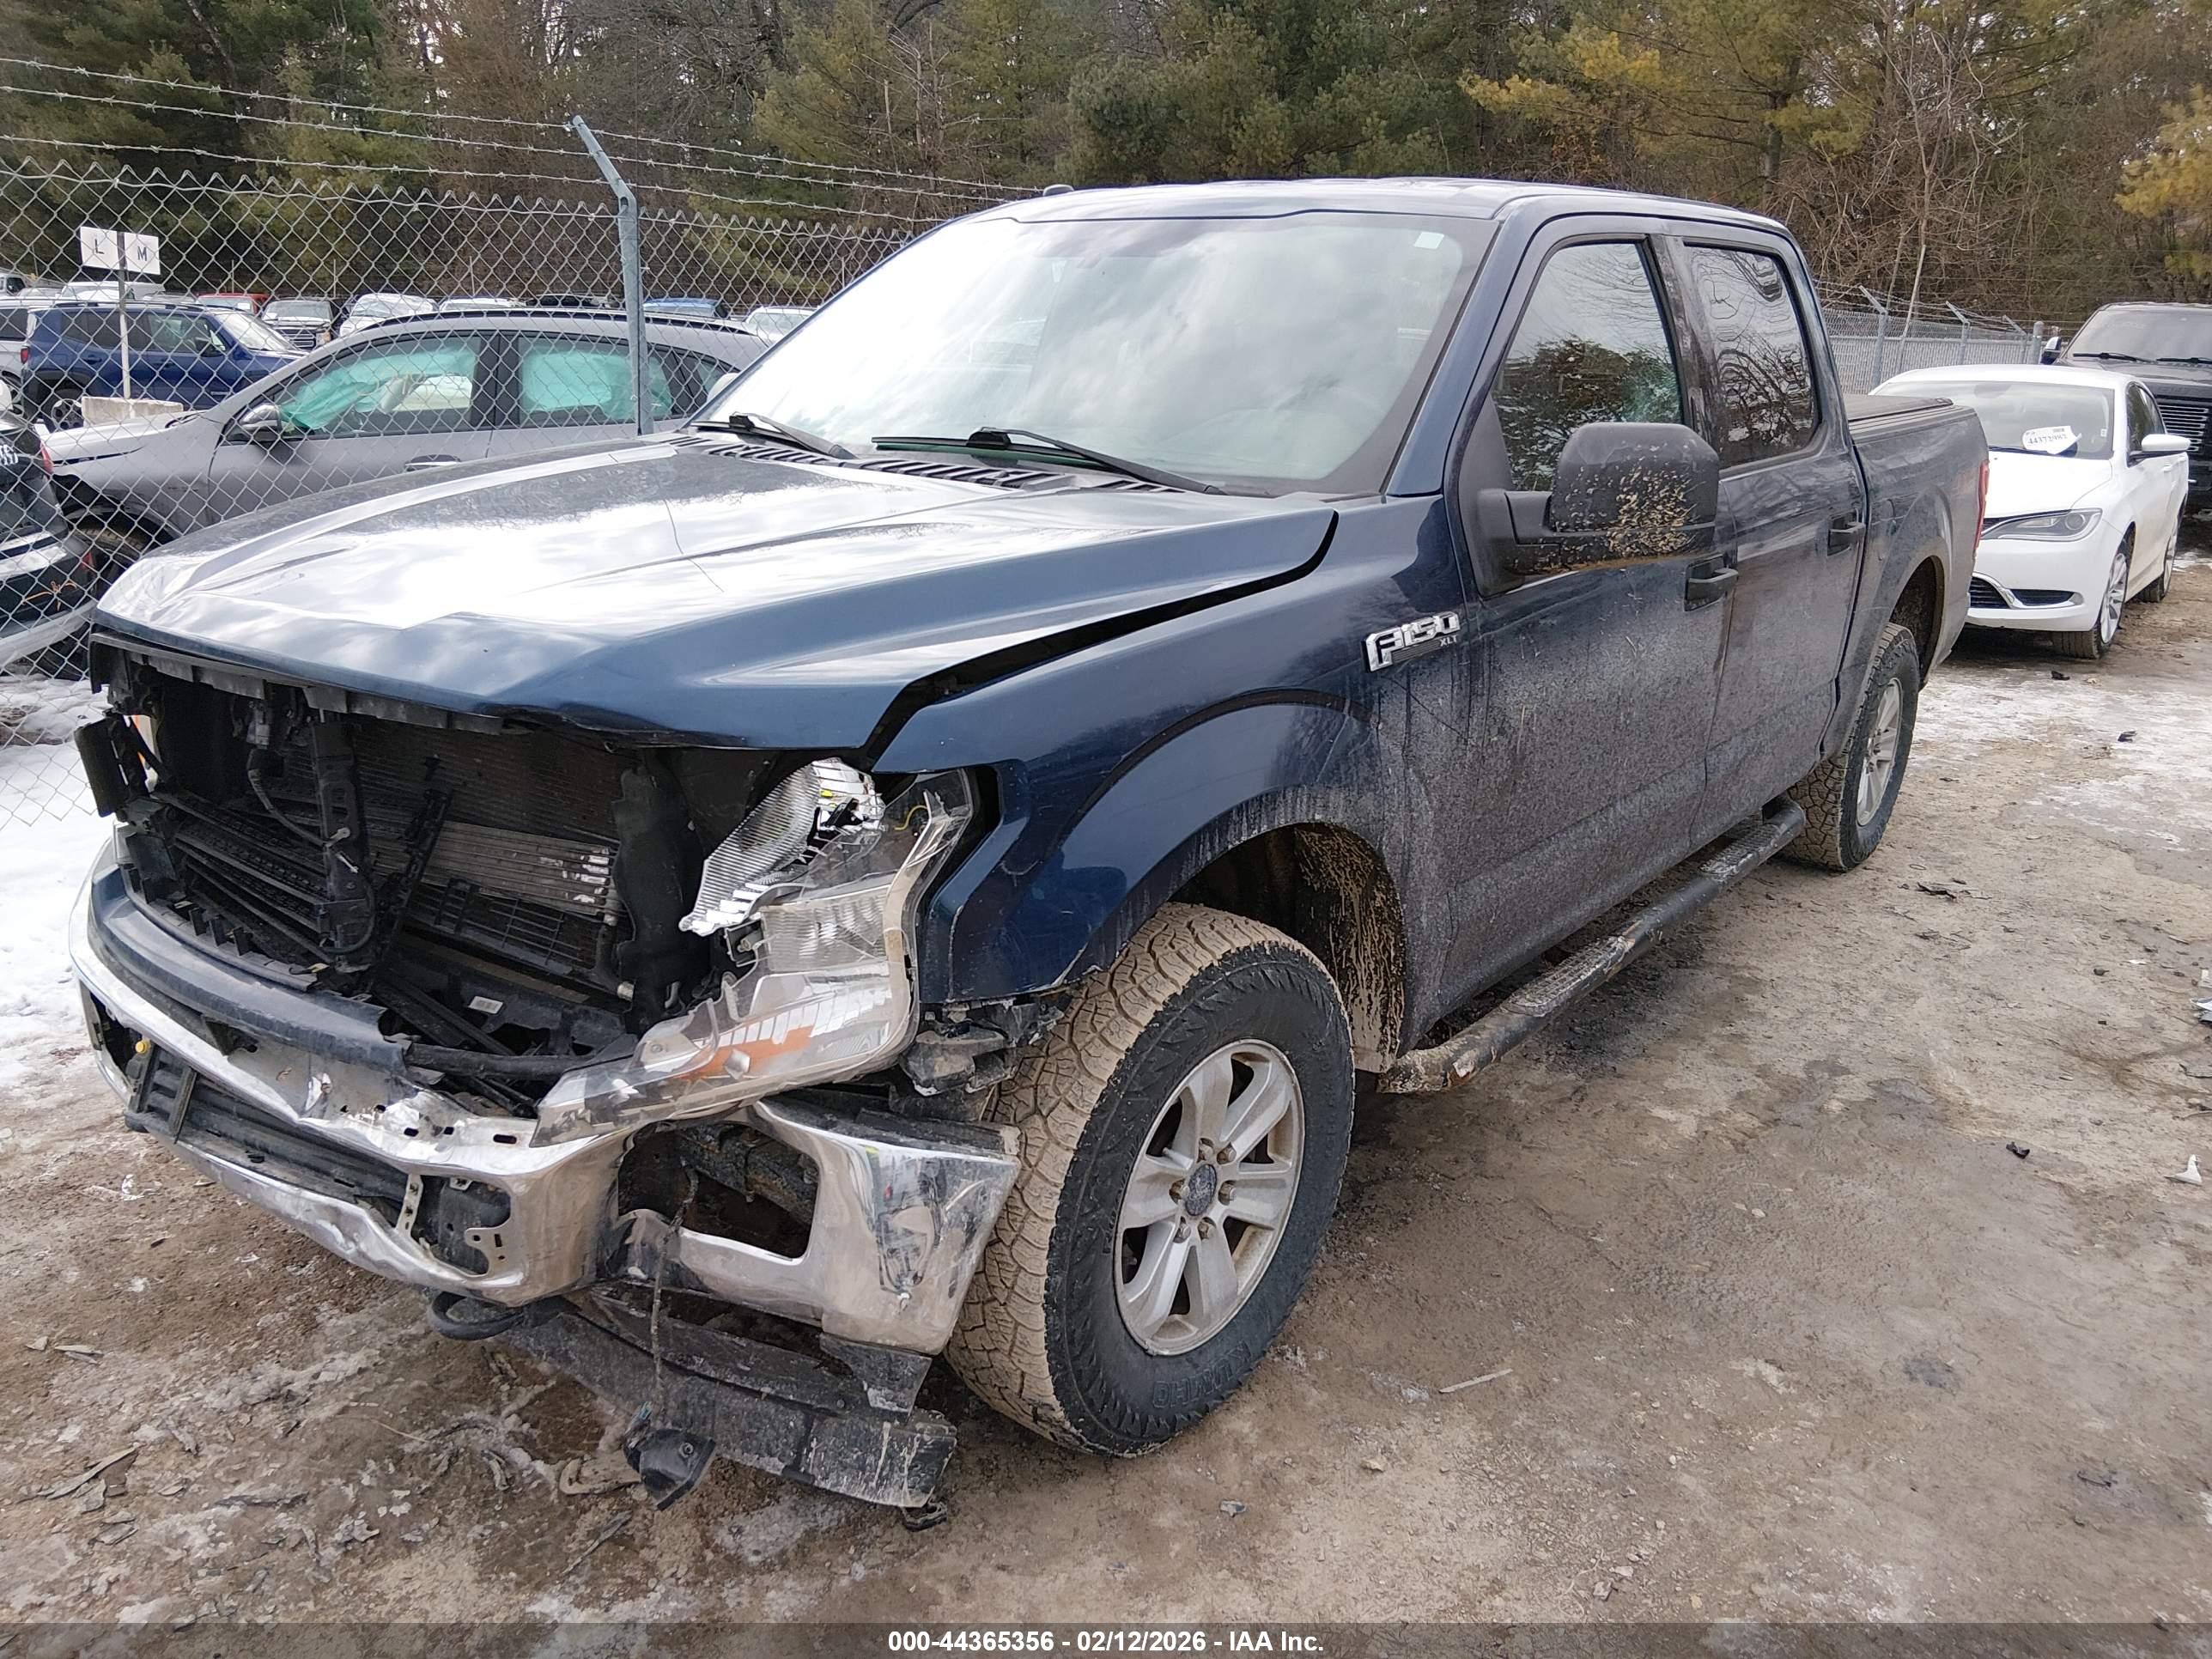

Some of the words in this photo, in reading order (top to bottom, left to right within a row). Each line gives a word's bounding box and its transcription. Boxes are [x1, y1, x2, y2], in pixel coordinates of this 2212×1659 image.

[94, 239, 105, 255] L
[137, 246, 148, 262] M
[1440, 635, 1457, 647] XLT
